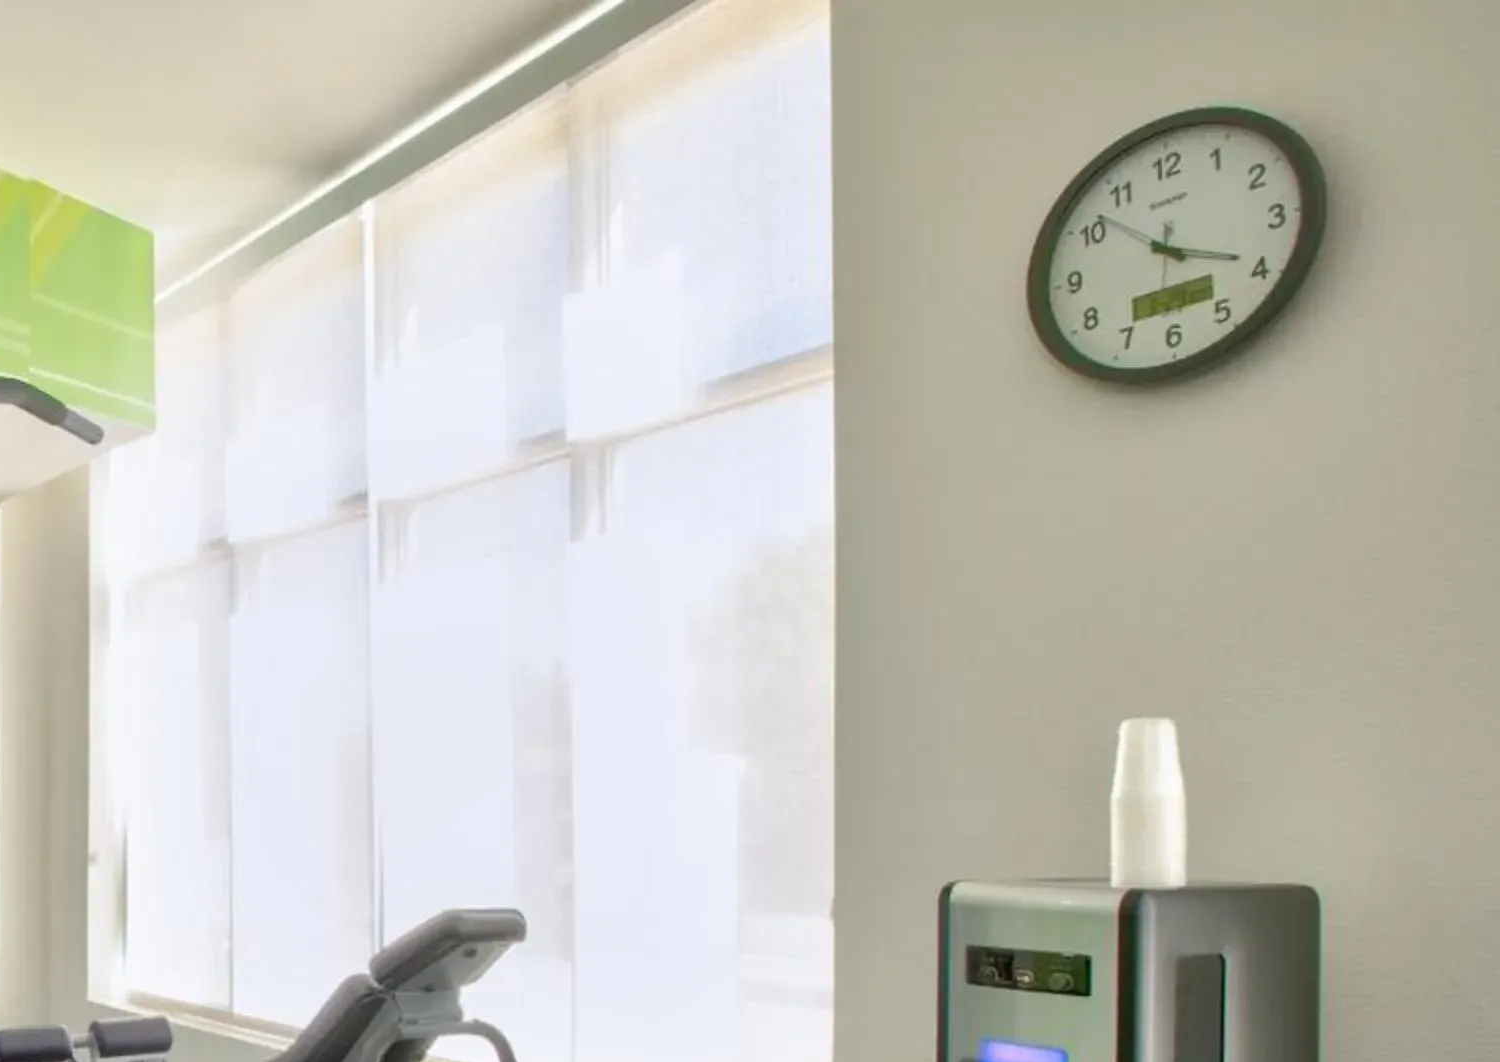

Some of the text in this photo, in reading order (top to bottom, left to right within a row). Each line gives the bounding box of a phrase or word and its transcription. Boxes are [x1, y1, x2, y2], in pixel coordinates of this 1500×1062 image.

[1152, 153, 1182, 181] 12
[1209, 148, 1222, 171] 1
[1248, 163, 1267, 190] 2
[1109, 182, 1133, 208] 11
[1267, 203, 1286, 229] 3
[1079, 220, 1106, 247] 10
[1251, 256, 1270, 280] 4
[1067, 271, 1083, 294] 9
[1083, 307, 1099, 331] 8
[1214, 299, 1232, 324] 5
[1118, 326, 1134, 350] 7
[1165, 324, 1183, 349] 6
